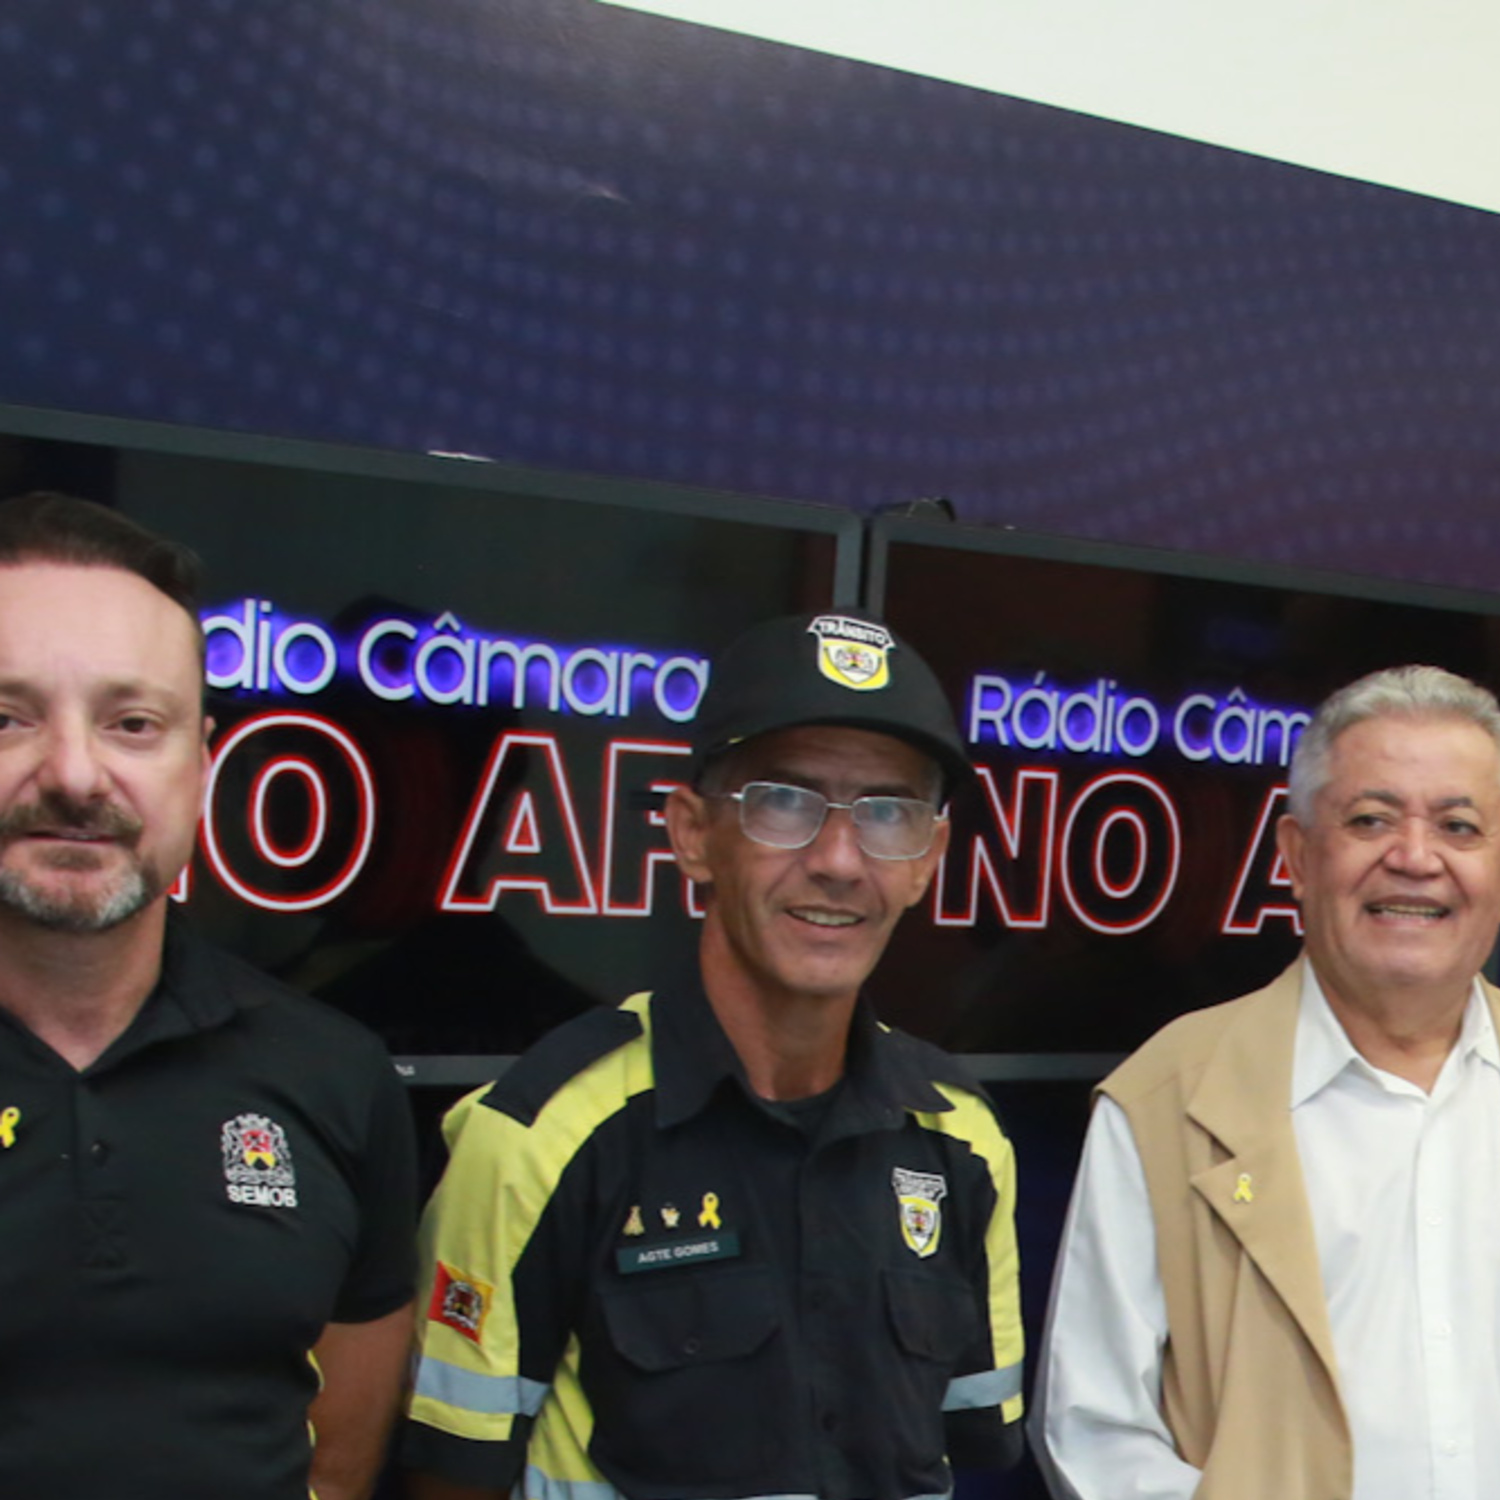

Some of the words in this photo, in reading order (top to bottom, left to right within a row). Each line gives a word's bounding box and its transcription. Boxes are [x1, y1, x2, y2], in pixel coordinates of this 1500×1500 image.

[203, 599, 337, 695] dio
[358, 611, 710, 723] Câmara
[968, 671, 1160, 758] Rádio
[1174, 686, 1312, 766] Câm
[168, 710, 375, 913] O
[932, 764, 1182, 935] NO
[225, 1184, 299, 1208] SEMOB
[637, 1247, 672, 1264] AGTE
[673, 1241, 720, 1259] GOMES
